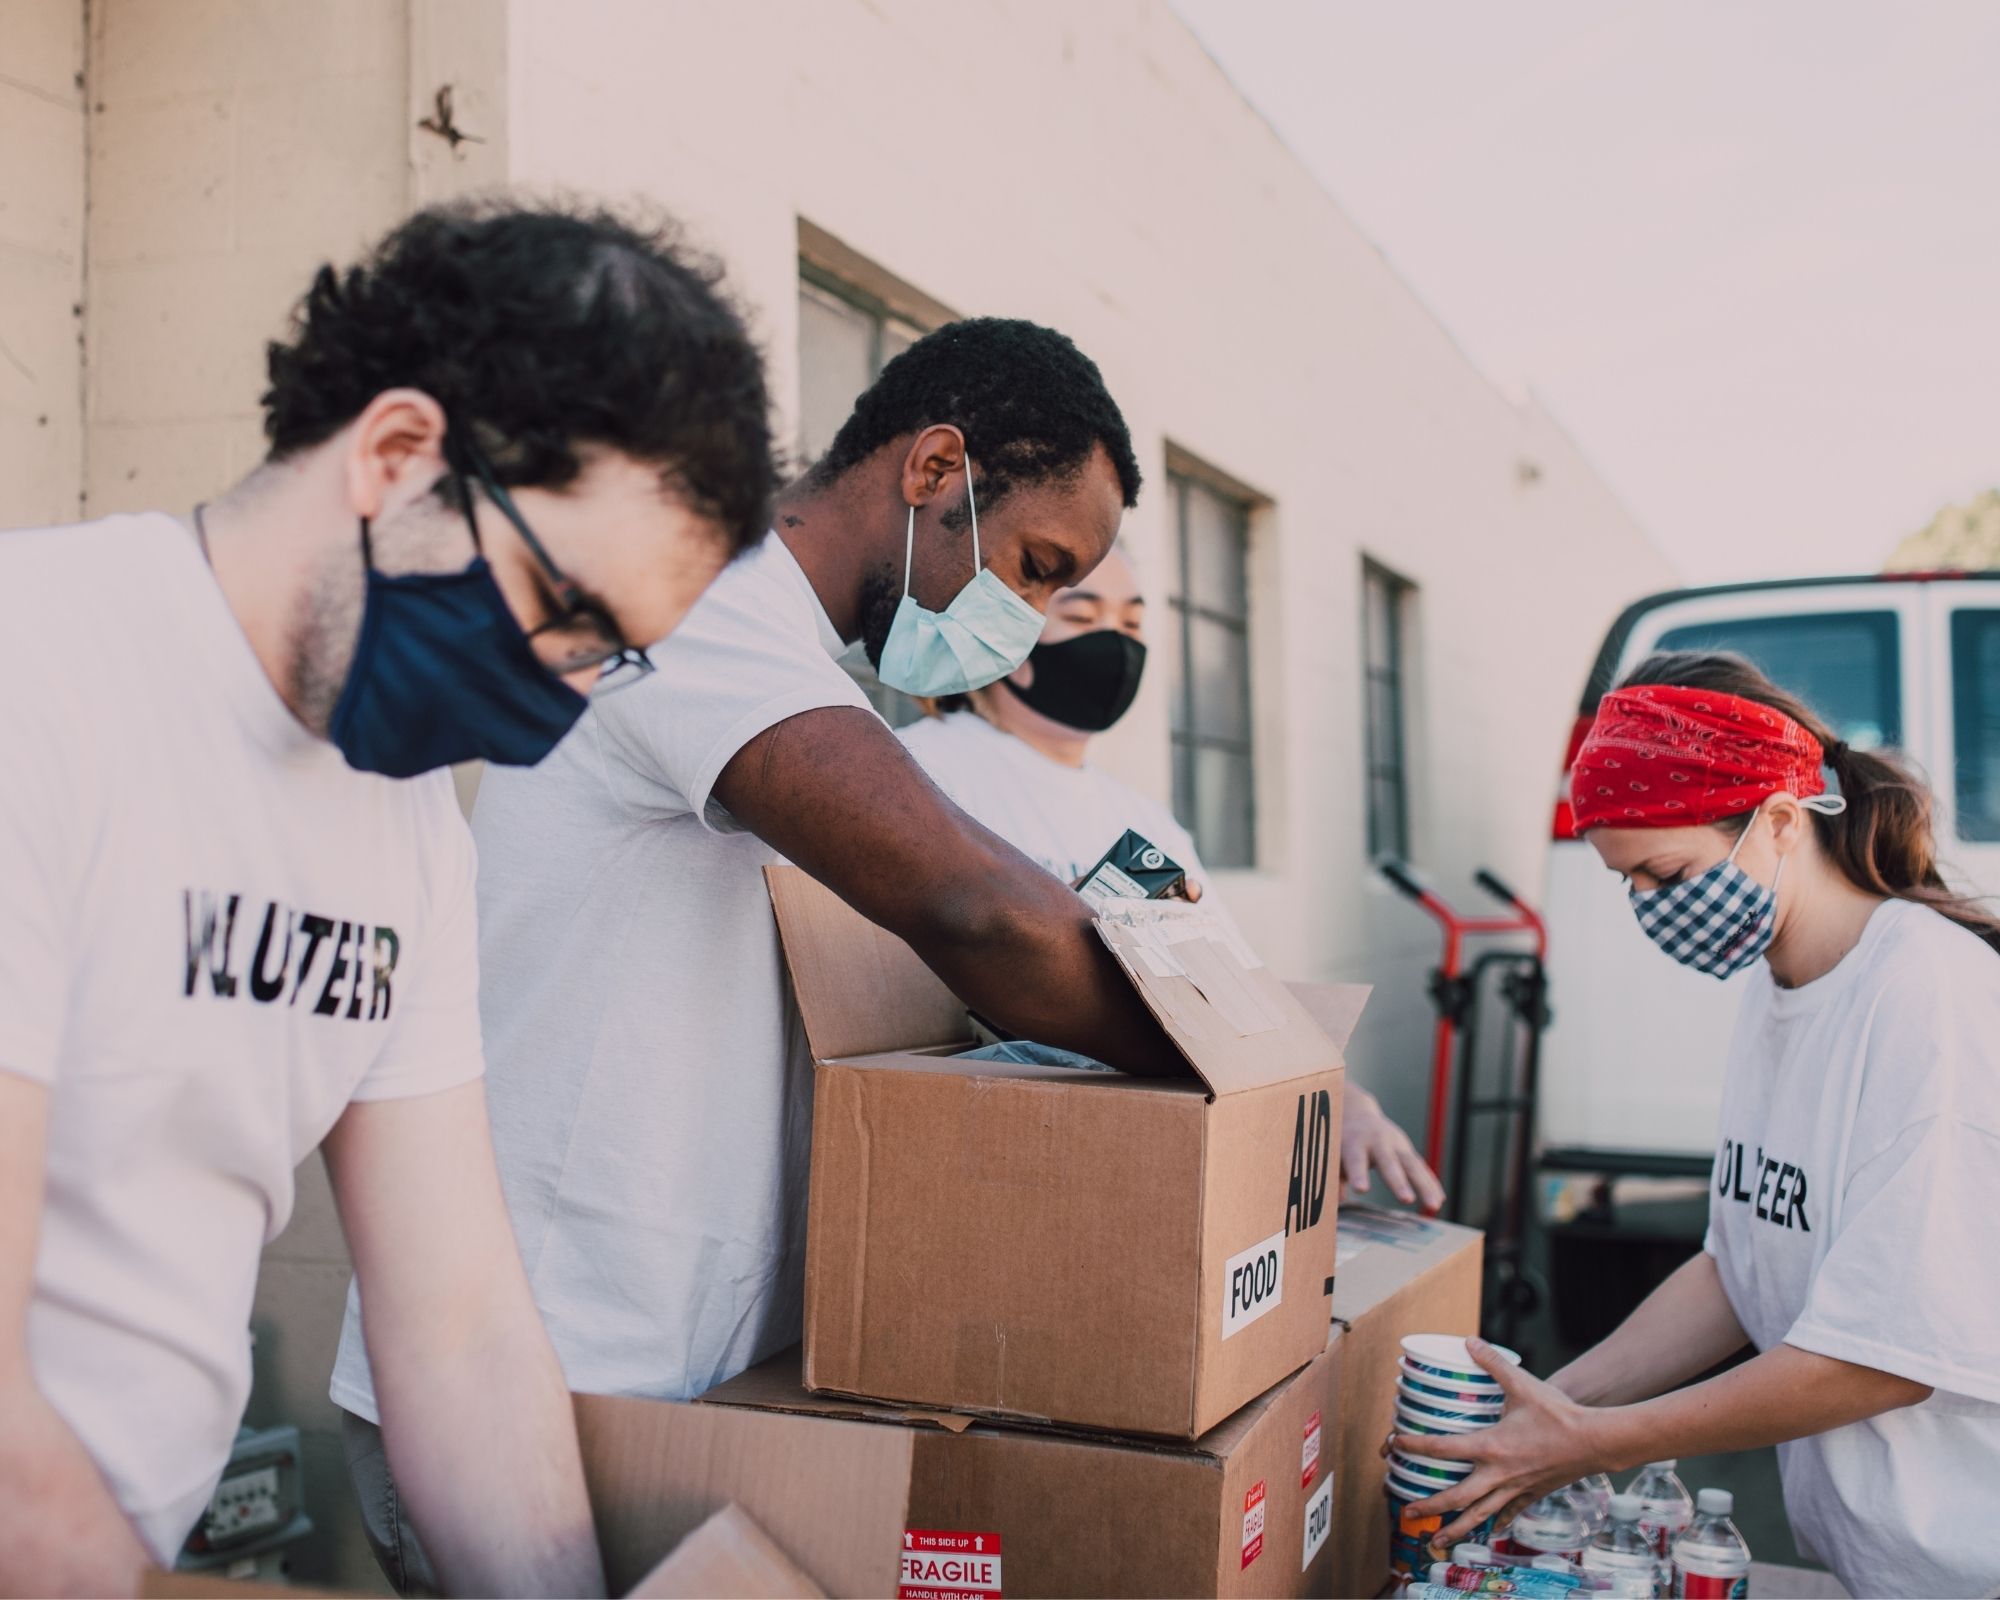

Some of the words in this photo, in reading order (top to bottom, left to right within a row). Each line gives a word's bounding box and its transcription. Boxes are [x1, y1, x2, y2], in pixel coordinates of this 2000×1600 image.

[1284, 1089, 1330, 1238] AID
[1231, 1249, 1278, 1318] FOOD
[919, 1537, 936, 1546] THIS
[938, 1538, 956, 1547] SIDE
[957, 1539, 969, 1548] UP
[900, 1558, 992, 1585] FRAGILE
[906, 1589, 938, 1600] HANDLE
[940, 1591, 960, 1600] WITH
